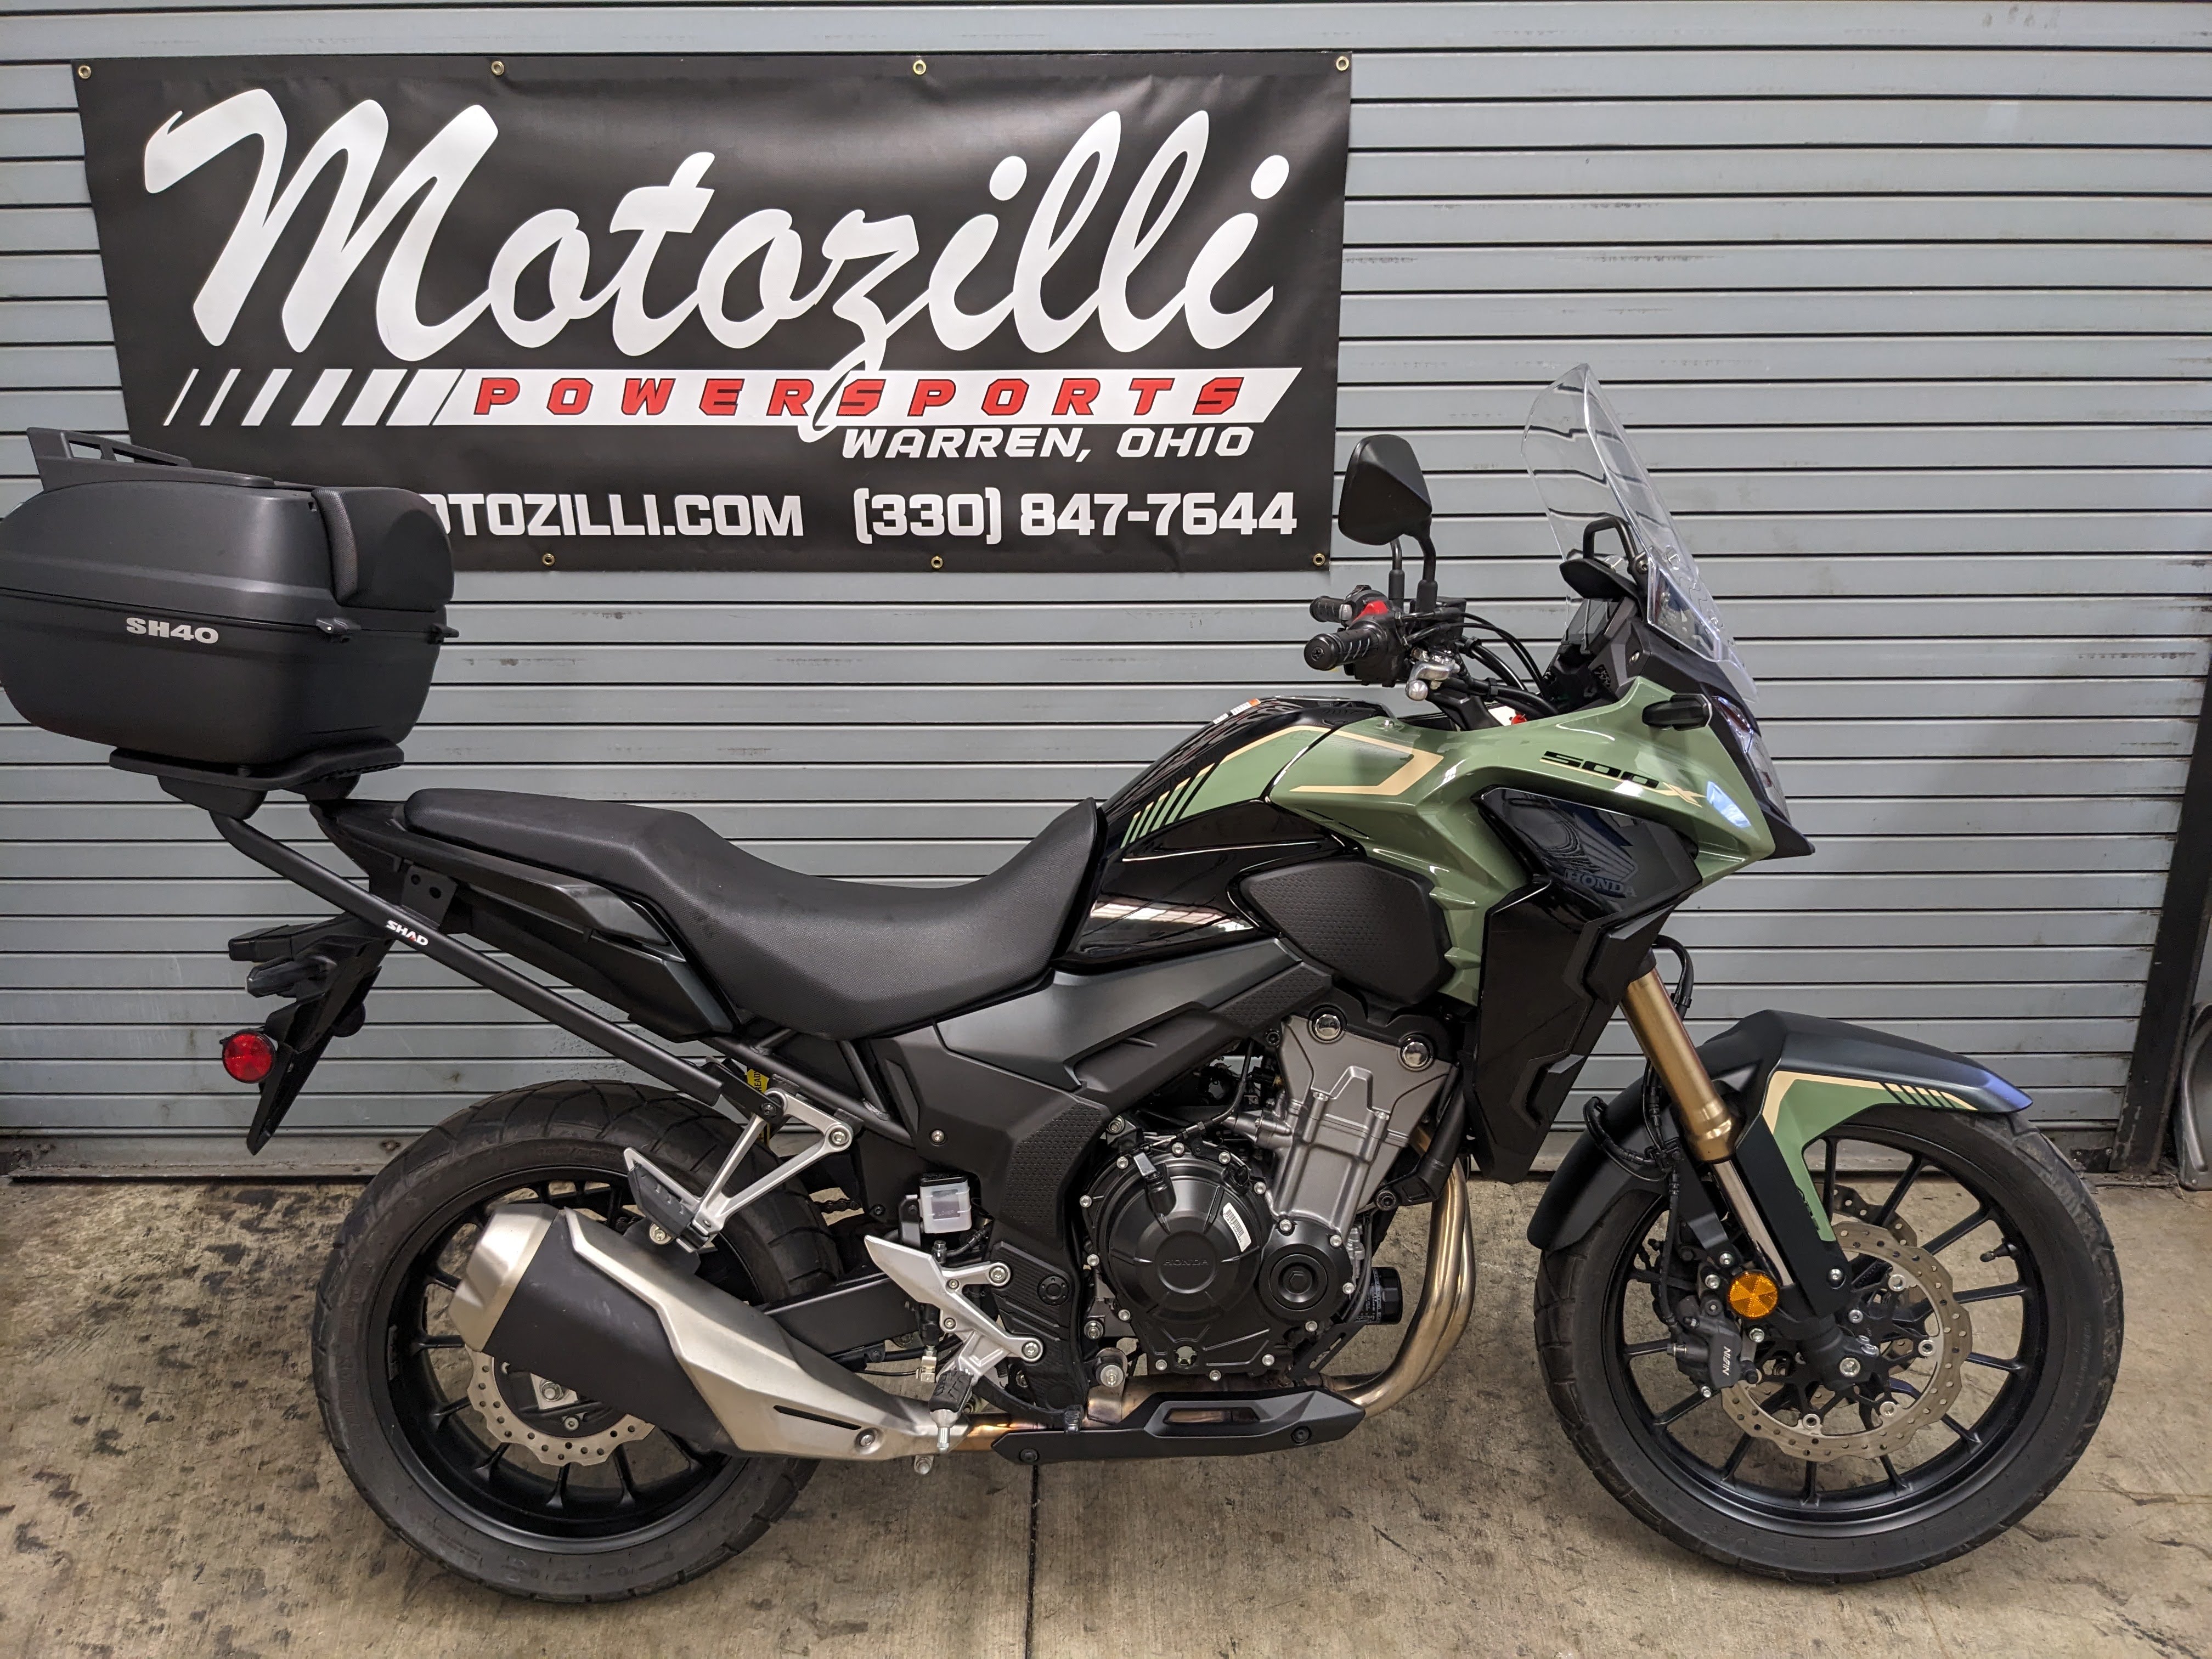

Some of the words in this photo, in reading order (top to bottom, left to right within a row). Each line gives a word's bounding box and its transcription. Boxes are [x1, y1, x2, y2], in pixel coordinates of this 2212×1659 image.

[144, 88, 1290, 443] Motozilli
[473, 377, 1244, 417] POWERSPORTS
[842, 427, 1090, 463] WARREN,
[1116, 426, 1254, 458] OHIO
[853, 487, 1002, 545] (330)
[1020, 492, 1297, 536] 847-7644
[126, 617, 219, 644] SH40
[1564, 868, 1637, 897] HONDA
[386, 920, 428, 946] SHAD
